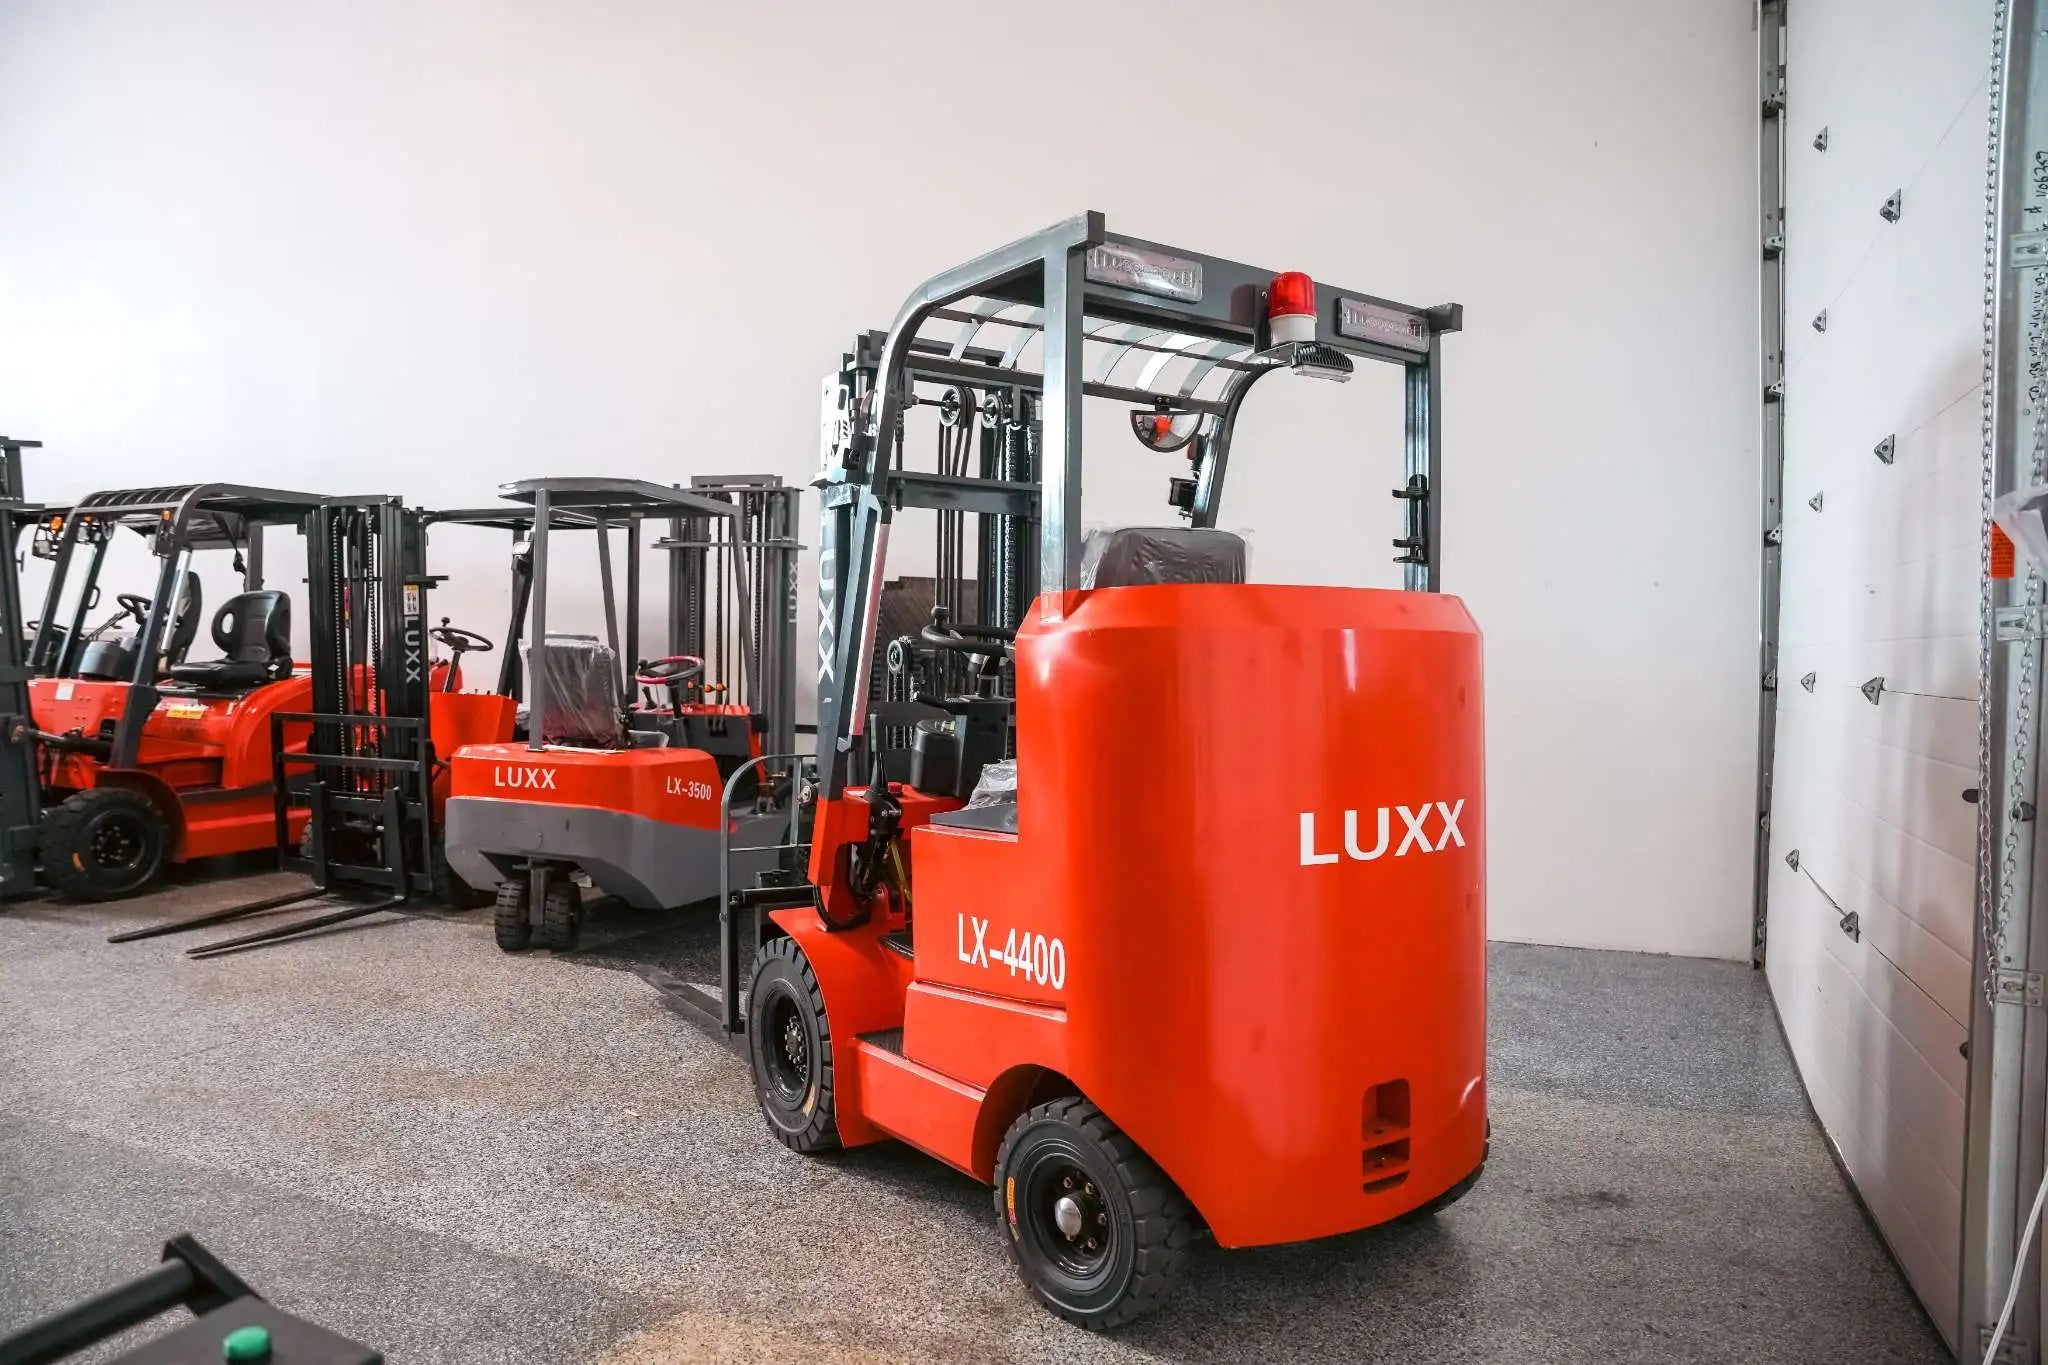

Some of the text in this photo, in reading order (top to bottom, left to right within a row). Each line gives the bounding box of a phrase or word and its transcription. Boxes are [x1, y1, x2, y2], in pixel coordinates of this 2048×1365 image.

[404, 616, 421, 683] LUXX
[494, 766, 556, 789] LUXX
[666, 775, 712, 800] LX-3500
[1299, 798, 1466, 866] LUXX
[958, 912, 1066, 990] LX-4400
